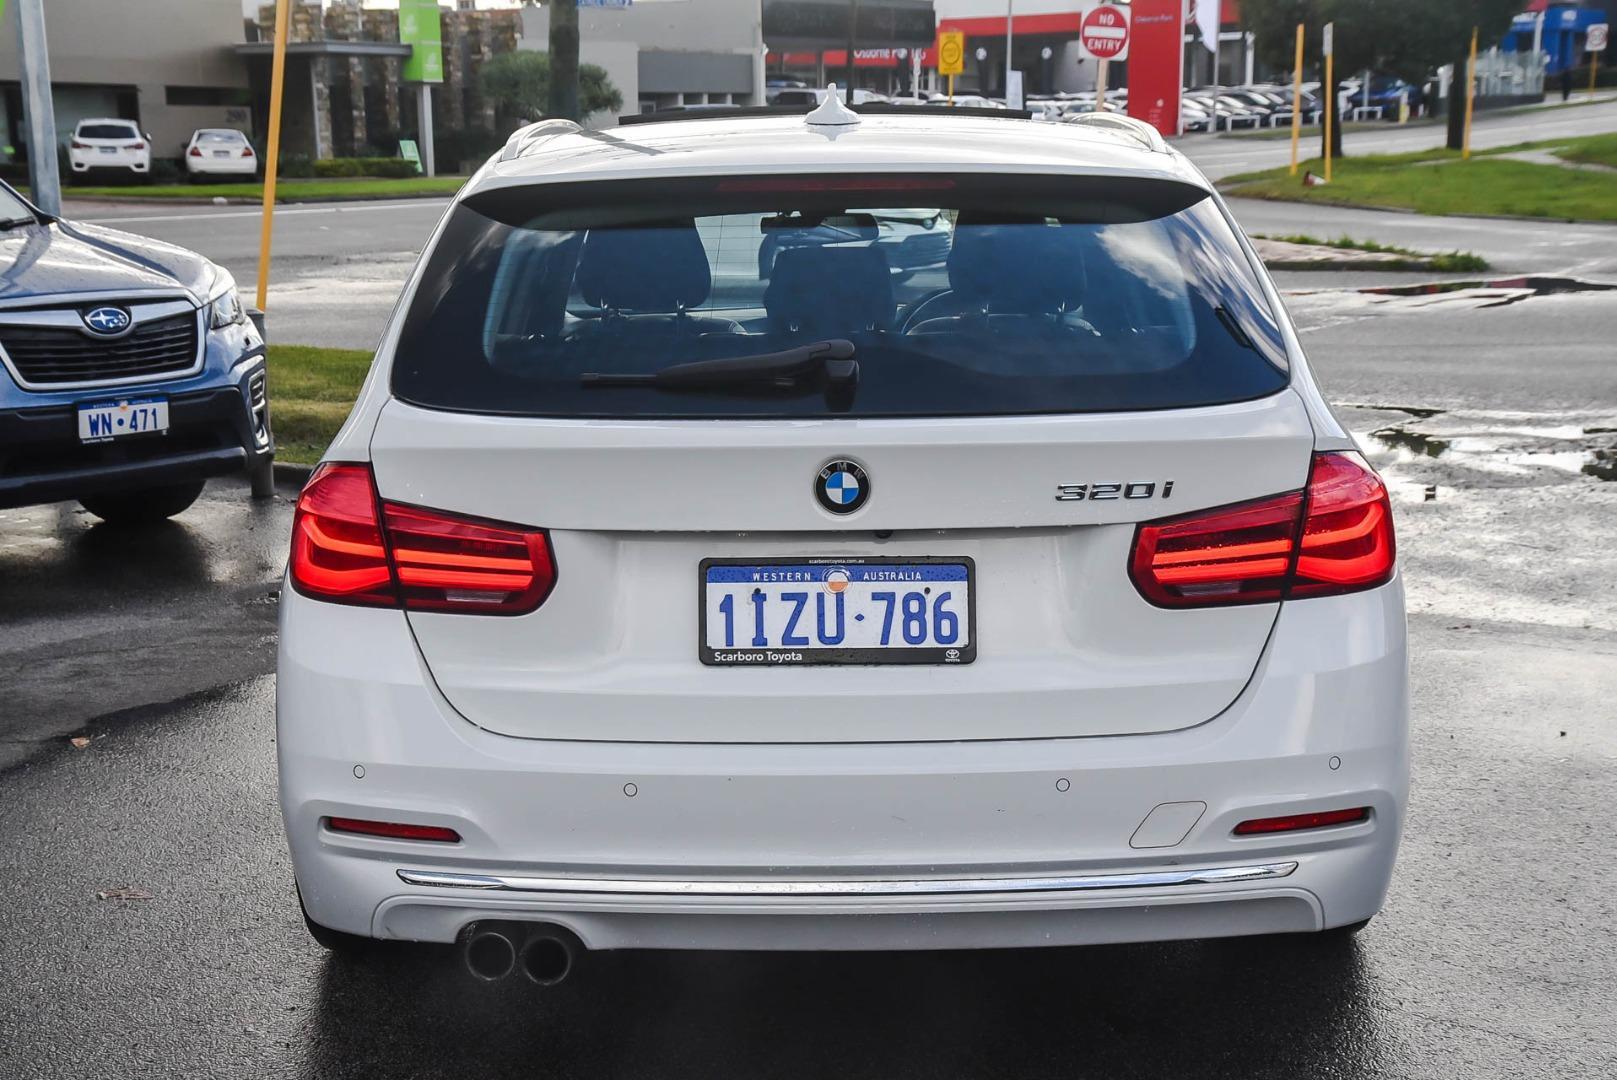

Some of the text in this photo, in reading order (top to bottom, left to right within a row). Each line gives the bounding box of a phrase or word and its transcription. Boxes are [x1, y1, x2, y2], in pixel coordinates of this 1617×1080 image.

[1098, 13, 1116, 26] NO
[1087, 38, 1122, 51] ENTRY
[1055, 480, 1175, 502] 320i
[752, 571, 922, 582] WESTERN AUSTRALIA
[714, 651, 803, 663] Scarboro Toyota
